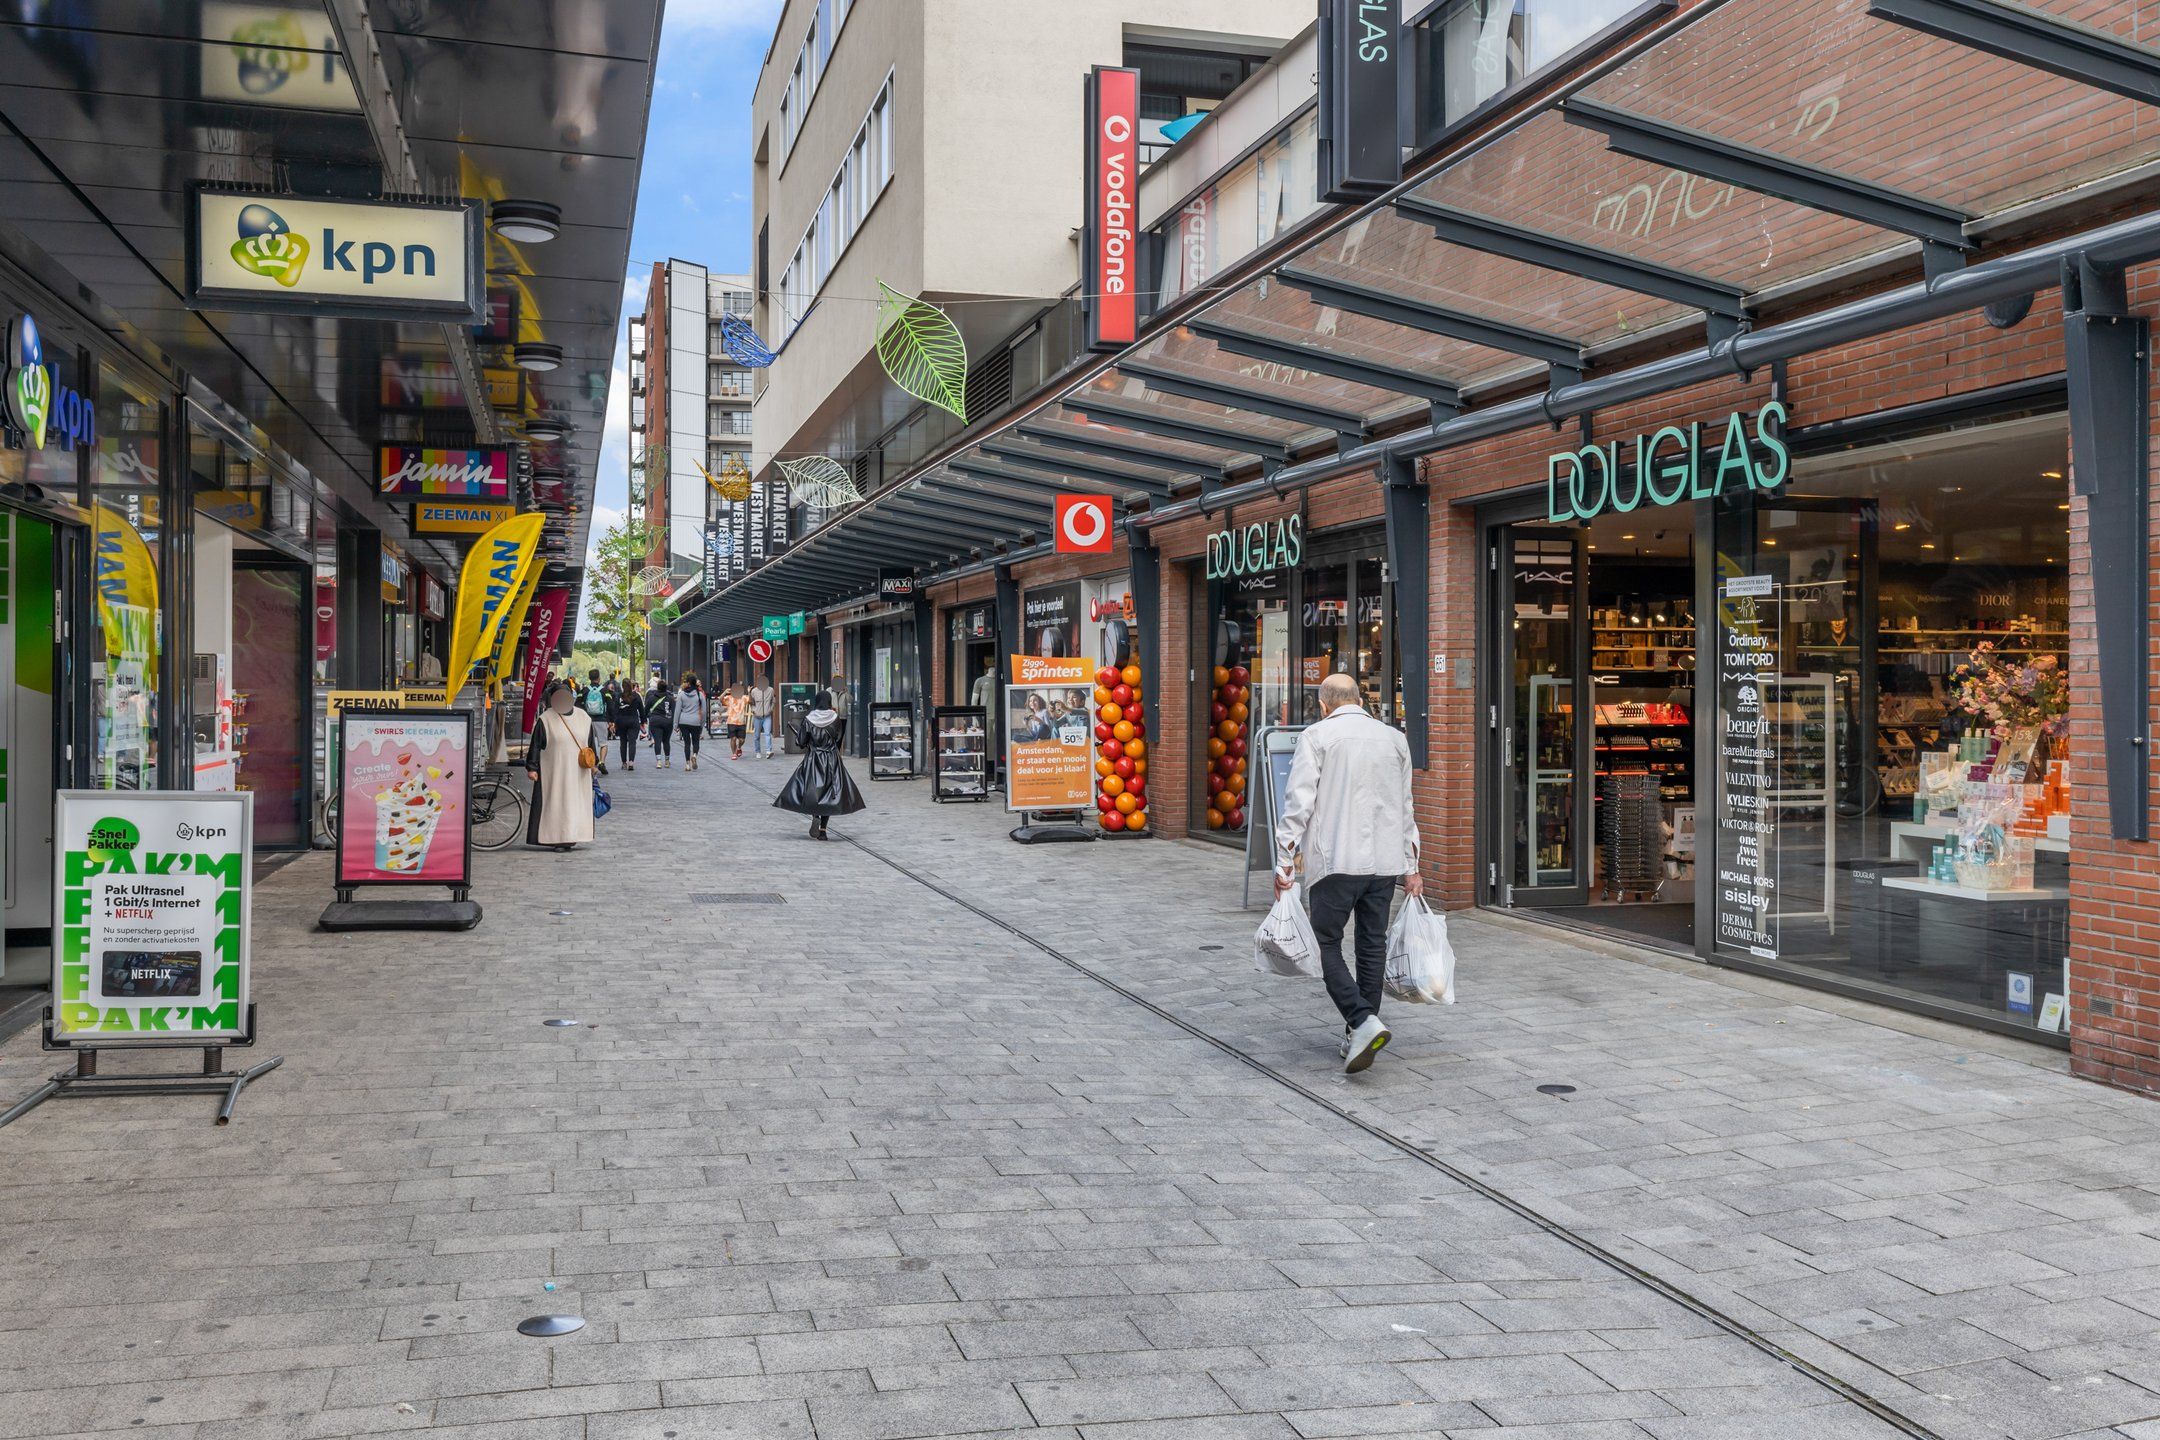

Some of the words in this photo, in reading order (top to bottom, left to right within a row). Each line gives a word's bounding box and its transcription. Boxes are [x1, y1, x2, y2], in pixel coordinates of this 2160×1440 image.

[1358, 0, 1388, 62] LAS
[1106, 153, 1131, 293] vodafone
[323, 228, 436, 284] kpn
[53, 363, 95, 450] kpn
[1549, 401, 1789, 523] DOUGLAS
[381, 453, 506, 492] jamin
[423, 509, 491, 521] ZEEMAN
[773, 480, 787, 545] STMARKET
[751, 481, 763, 559] WESTMARKET
[733, 501, 745, 571] WESTMARKET
[1206, 514, 1300, 581] DOUGLAS
[479, 539, 521, 634] EMAN
[1046, 596, 1064, 611] voordeel
[1979, 594, 2011, 607] DIOR
[765, 627, 786, 635] Pearle
[1729, 634, 1769, 650] Ordinary.
[1022, 658, 1045, 668] Ziggo
[1724, 653, 1746, 666] TOM
[1746, 653, 1774, 666] FORD
[1021, 665, 1083, 681] sprinters
[333, 698, 399, 709] ZEEMAN
[404, 693, 448, 702] ZEEMAN
[419, 728, 447, 736] CREAM
[1726, 714, 1770, 738] benefit
[1064, 734, 1083, 743] 50%
[2015, 730, 2033, 740] 15%
[1017, 747, 1064, 755] Amsterdam,
[1722, 745, 1774, 759] bareMinerals
[1063, 755, 1087, 763] mooie
[354, 763, 391, 775] Create
[1017, 766, 1034, 774] deal
[1055, 765, 1063, 774] je
[1725, 771, 1772, 789] VALENTINO
[97, 829, 127, 839] Snel
[196, 826, 226, 839] kpn
[88, 840, 136, 850] Pakker
[1739, 835, 1758, 847] one.
[1721, 870, 1751, 884] MICHAEL
[1753, 876, 1774, 889] KORS
[1853, 870, 1875, 879] DOUGLAS
[105, 885, 128, 894] Pak
[131, 885, 184, 896] Ultrasnel
[104, 897, 110, 907] 1
[113, 897, 149, 908] Gbit/s
[152, 898, 201, 908] Internet
[1725, 888, 1769, 912] sisley
[115, 909, 153, 919] NETFLIX
[1739, 904, 1753, 912] PARIS
[1722, 912, 1752, 929] DERMA
[117, 927, 162, 936] superscherp
[163, 927, 195, 936] geprijsd
[1722, 924, 1773, 946] COSMETICS
[142, 936, 200, 944] activatiekosten
[131, 969, 171, 980] NETFLIX
[62, 1003, 239, 1031] PAK'M
